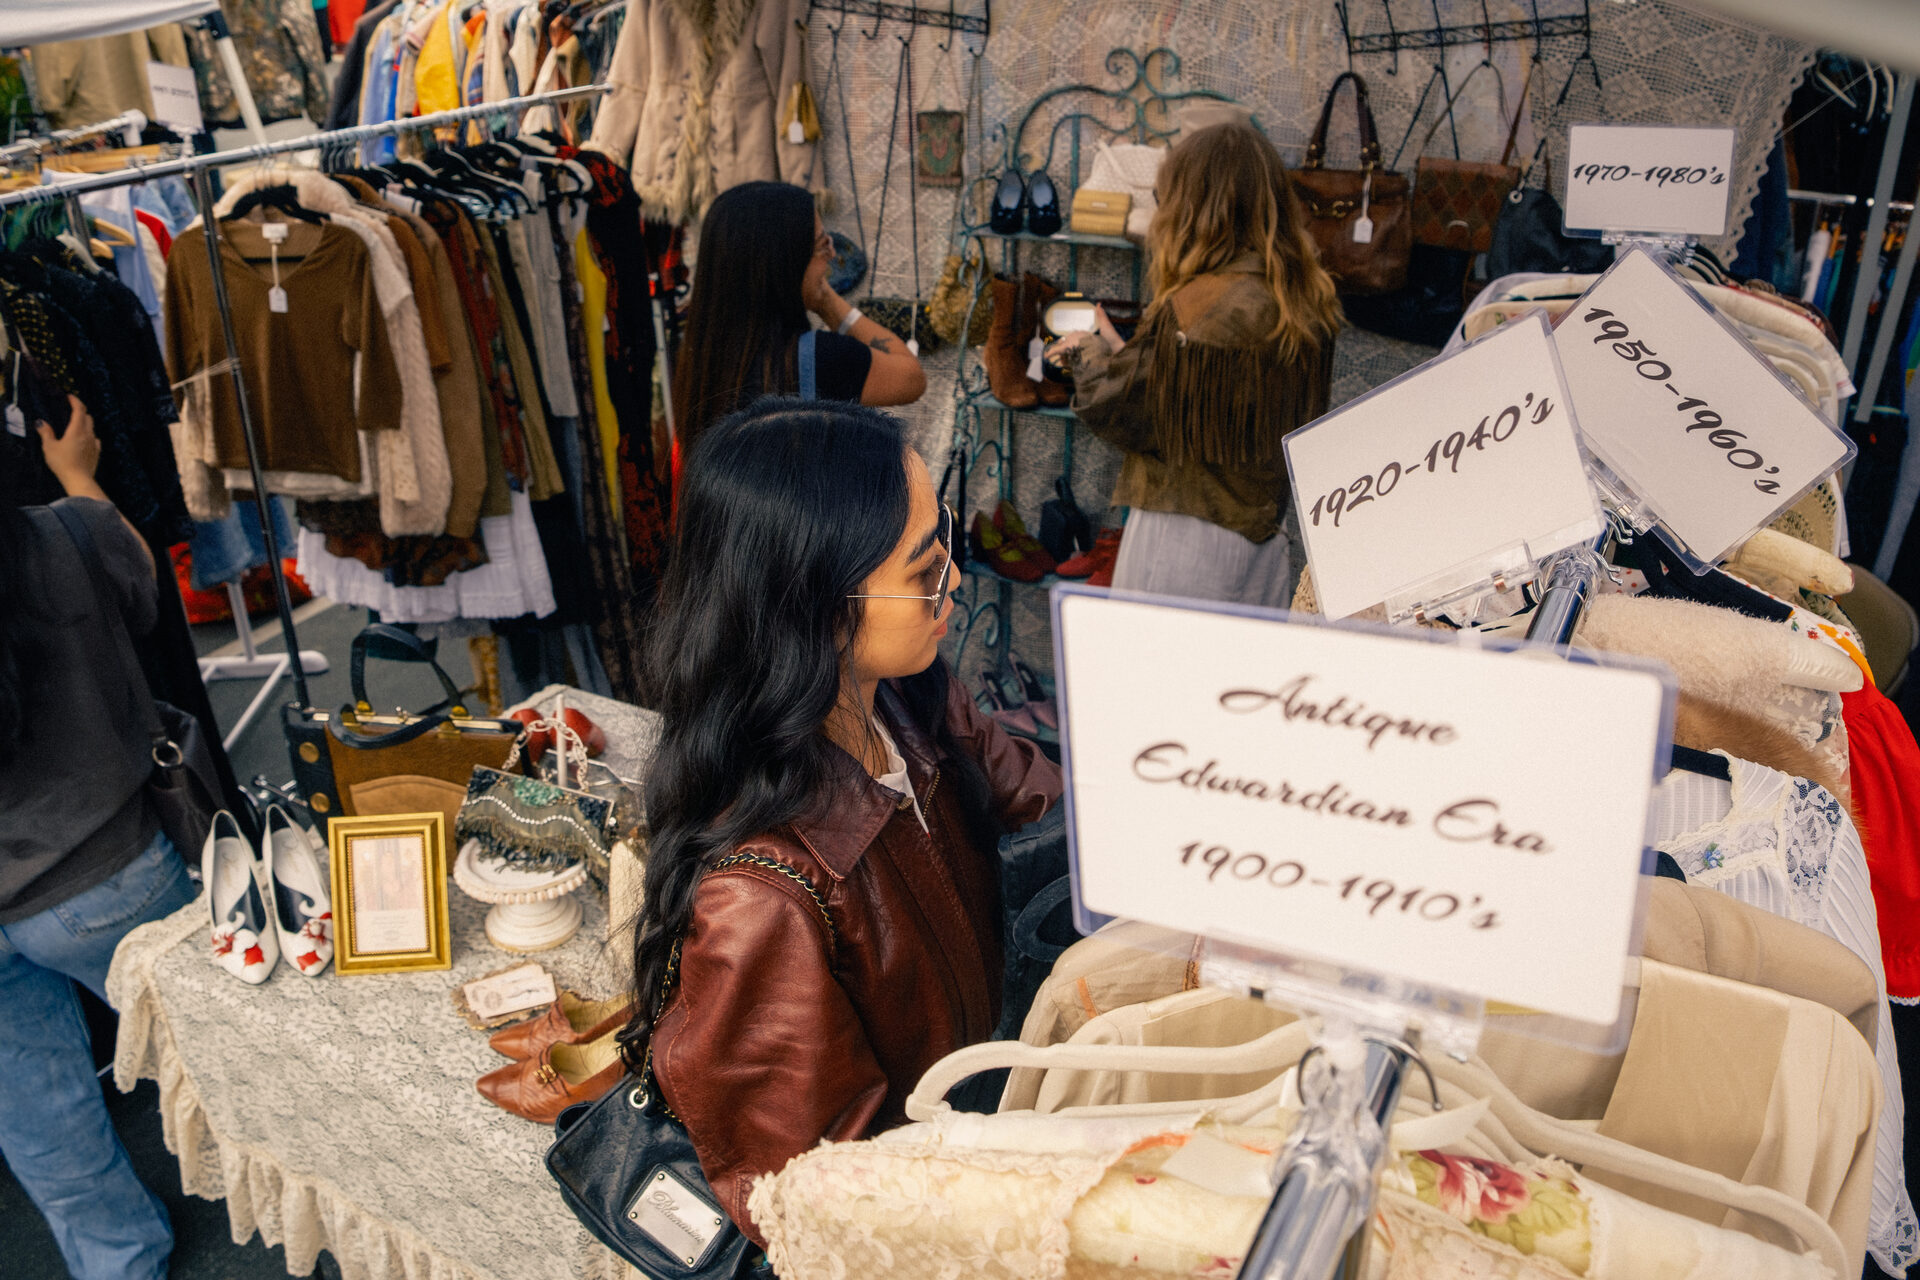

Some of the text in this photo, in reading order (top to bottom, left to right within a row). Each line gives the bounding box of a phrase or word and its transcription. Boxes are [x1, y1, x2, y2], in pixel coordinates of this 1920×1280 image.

[1573, 164, 1726, 187] 1970-1980's
[1584, 307, 1781, 495] 1950-1960's
[1309, 392, 1554, 527] 1920-1940's
[1219, 675, 1457, 750] Antique
[1133, 742, 1550, 854] Edwardian Era
[1179, 841, 1500, 930] 1900-1910's
